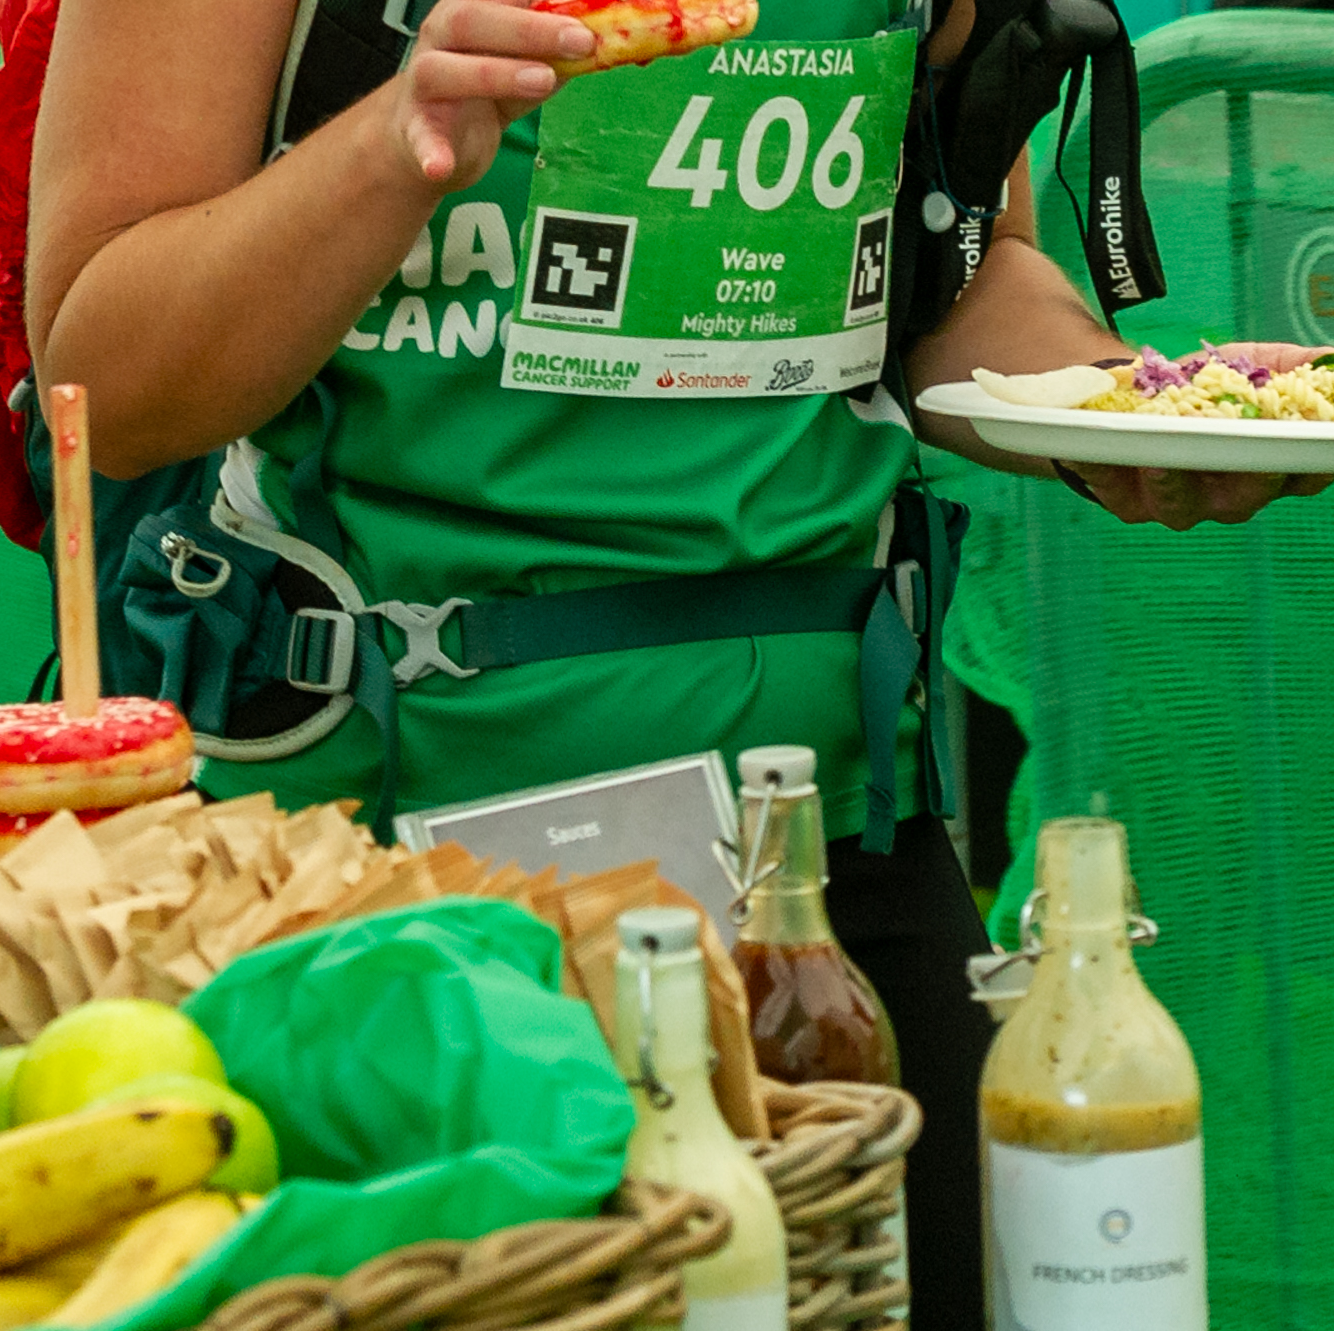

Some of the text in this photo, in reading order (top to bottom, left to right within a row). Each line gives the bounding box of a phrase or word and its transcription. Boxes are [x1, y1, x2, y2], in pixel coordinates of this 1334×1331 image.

[708, 47, 855, 77] ANASTASIA
[647, 94, 867, 211] 406
[1100, 175, 1130, 281] Eurohike
[722, 247, 786, 271] Wave
[716, 279, 777, 303] 07:10
[341, 295, 513, 359] CAN
[680, 312, 797, 337] Mighty Hikes
[512, 350, 641, 379] MACMILLAN
[512, 369, 631, 392] CANCER SUPPORT
[676, 371, 752, 389] Santander
[1032, 1256, 1189, 1284] FRENCH DRESSING
